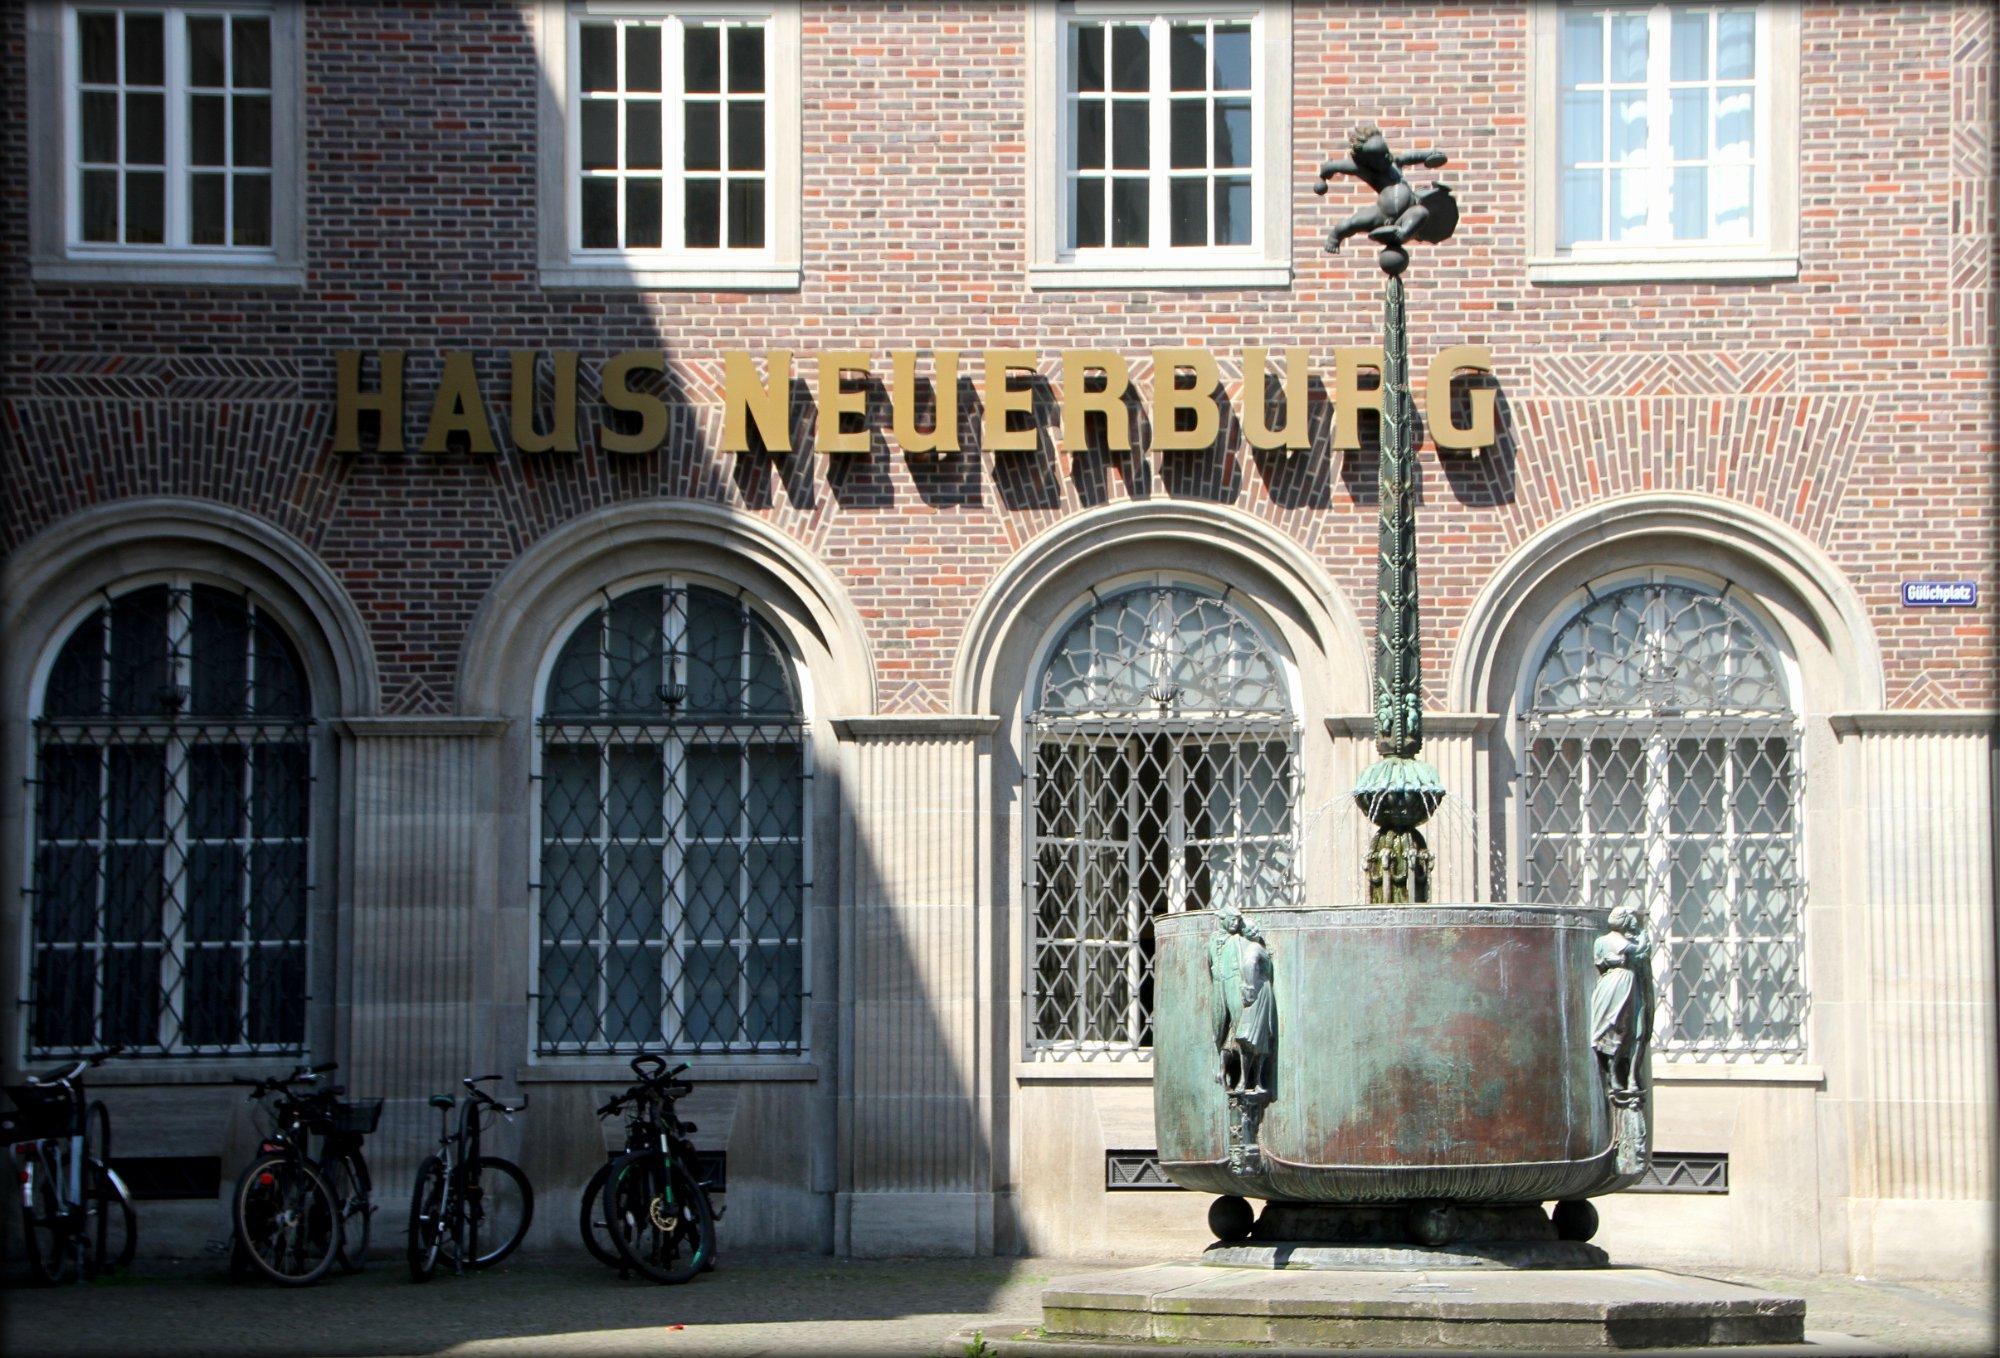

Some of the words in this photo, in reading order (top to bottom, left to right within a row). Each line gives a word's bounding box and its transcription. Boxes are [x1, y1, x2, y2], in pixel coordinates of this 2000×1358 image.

[333, 349, 668, 454] HAUS
[721, 345, 1498, 452] NEUERBURG
[1907, 584, 1971, 603] Gülichplatz
